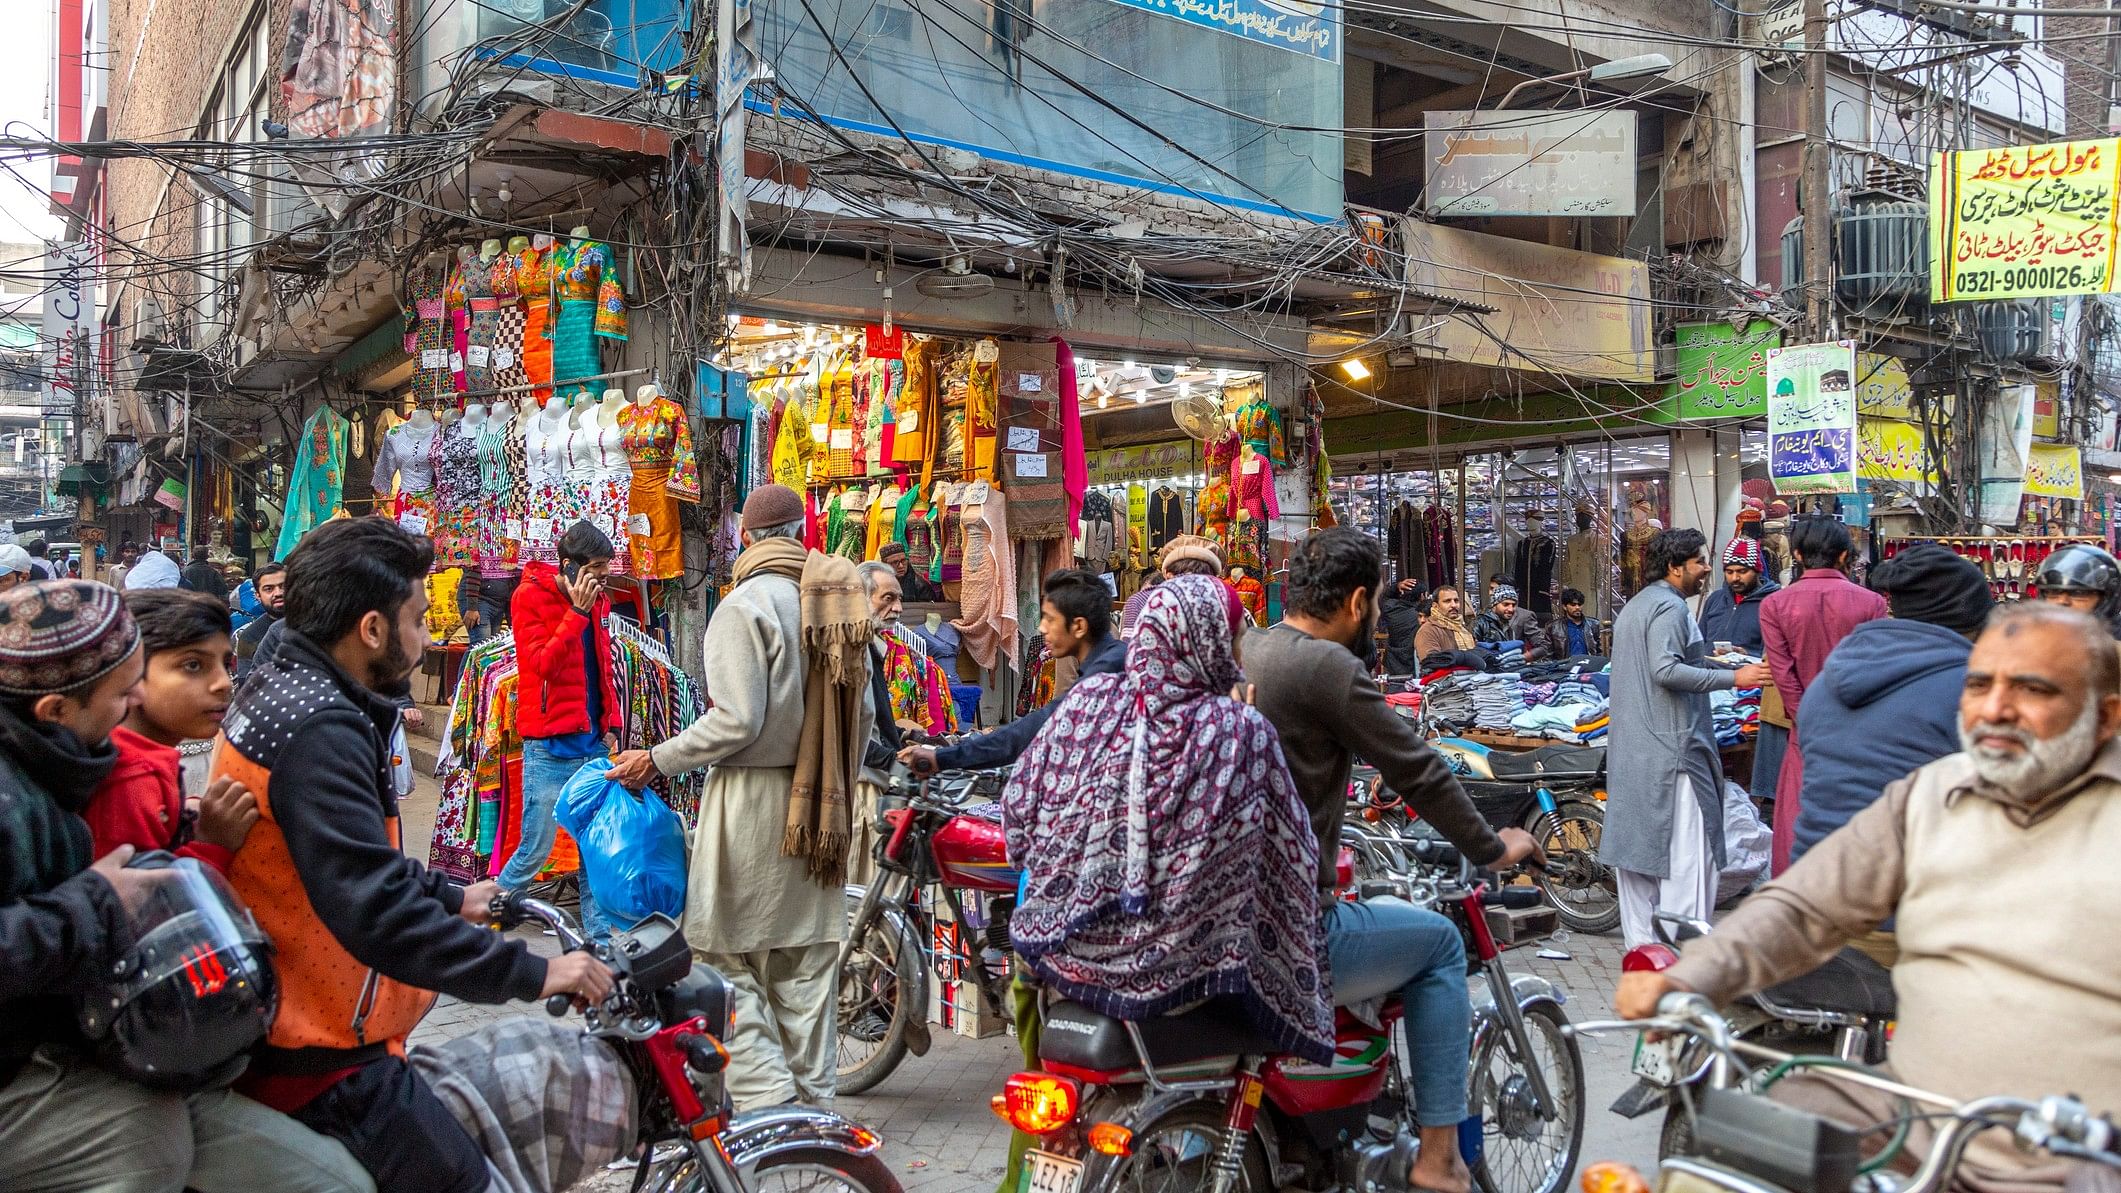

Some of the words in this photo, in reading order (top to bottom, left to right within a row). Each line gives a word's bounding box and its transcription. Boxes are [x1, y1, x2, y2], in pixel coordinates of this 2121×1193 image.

[1968, 149, 2011, 181] ڈیلر
[2009, 145, 2054, 179] سیل
[2049, 142, 2101, 176] ہول
[1441, 174, 1468, 195] پلازہ
[1961, 188, 1999, 225] جرسی
[1957, 265, 2082, 293] 0321-9000126
[1714, 389, 1739, 409] سیل
[1735, 388, 1761, 408] ہول
[1775, 433, 1809, 455] یونیفارم
[1104, 469, 1137, 482] DULHA
[1139, 466, 1173, 478] HOUSE
